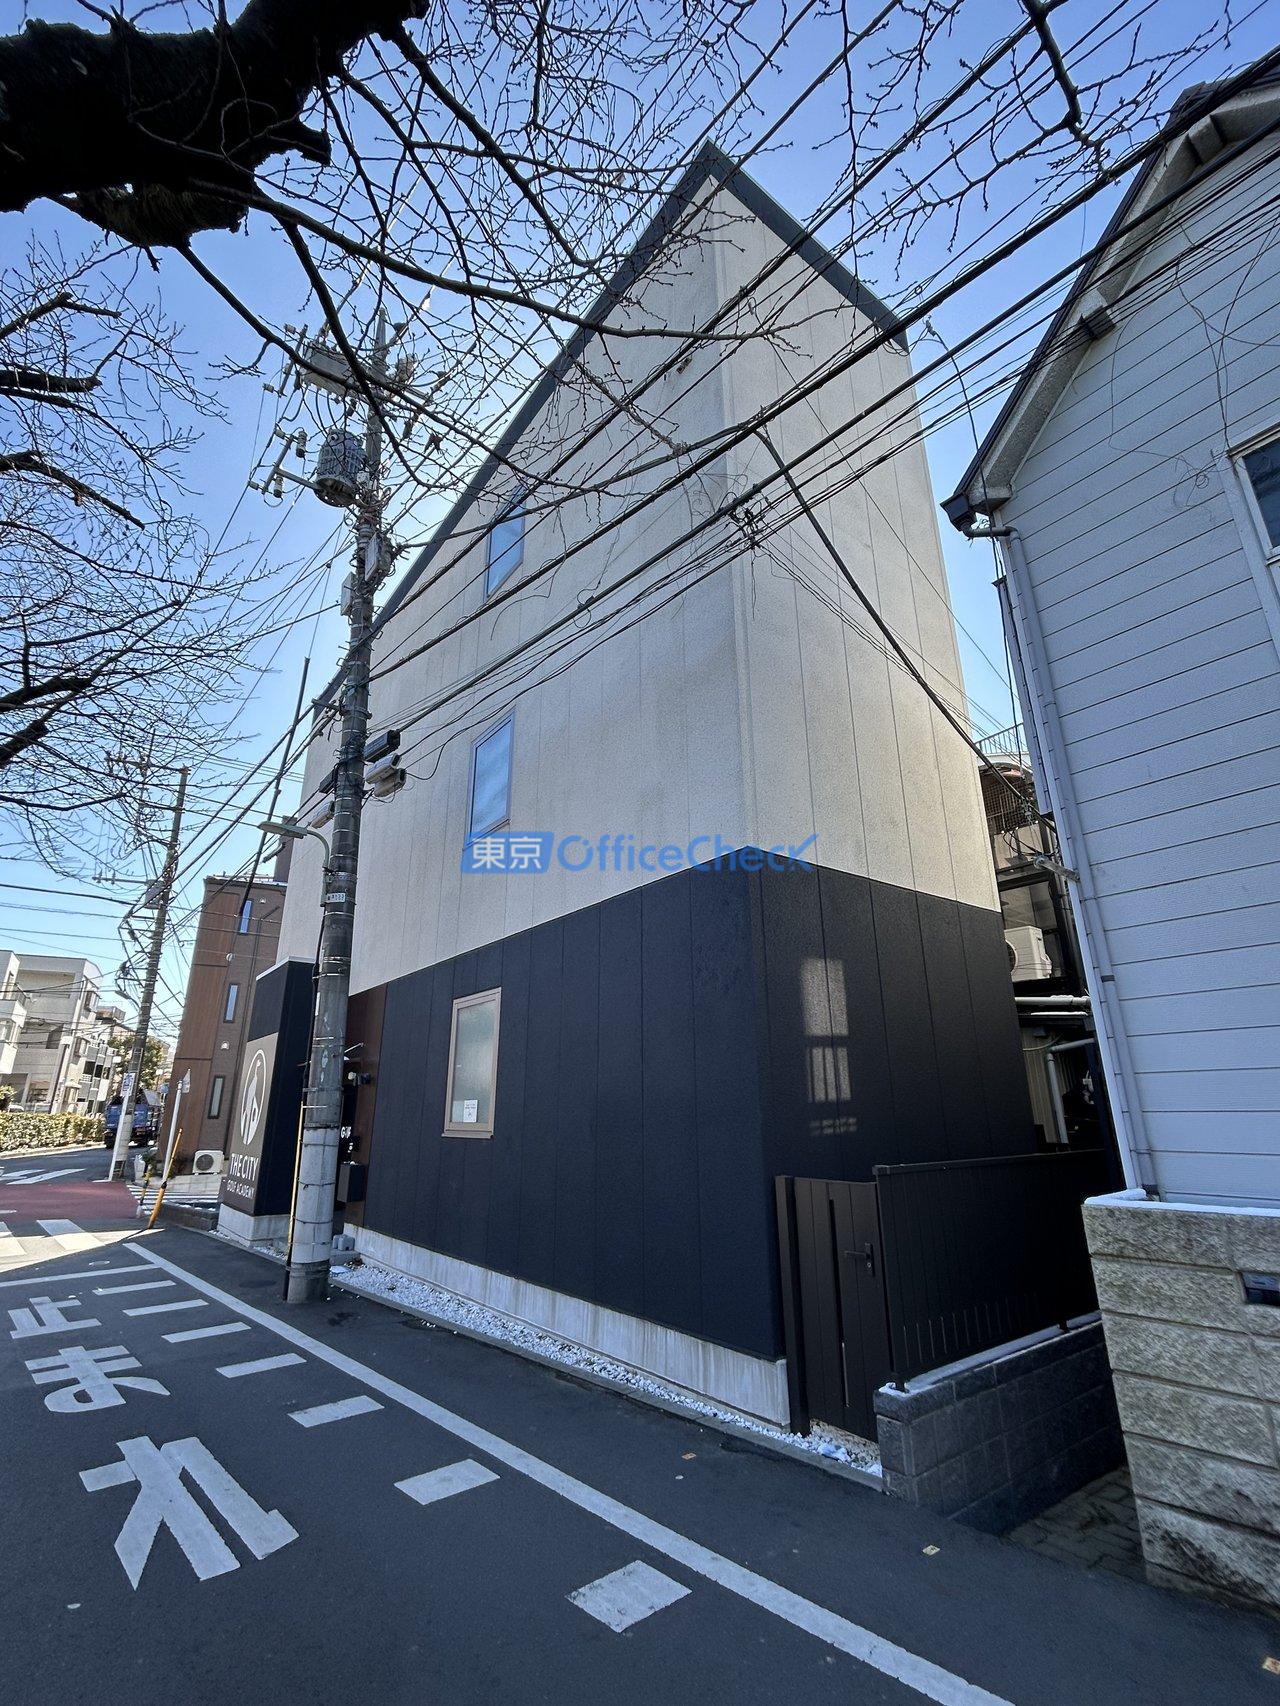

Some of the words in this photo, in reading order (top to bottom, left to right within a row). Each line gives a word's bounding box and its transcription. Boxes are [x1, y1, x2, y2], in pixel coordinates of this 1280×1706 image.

[230, 1153, 243, 1177] THE
[242, 1155, 259, 1181] CITY
[8, 1297, 300, 1591] 止まれ
